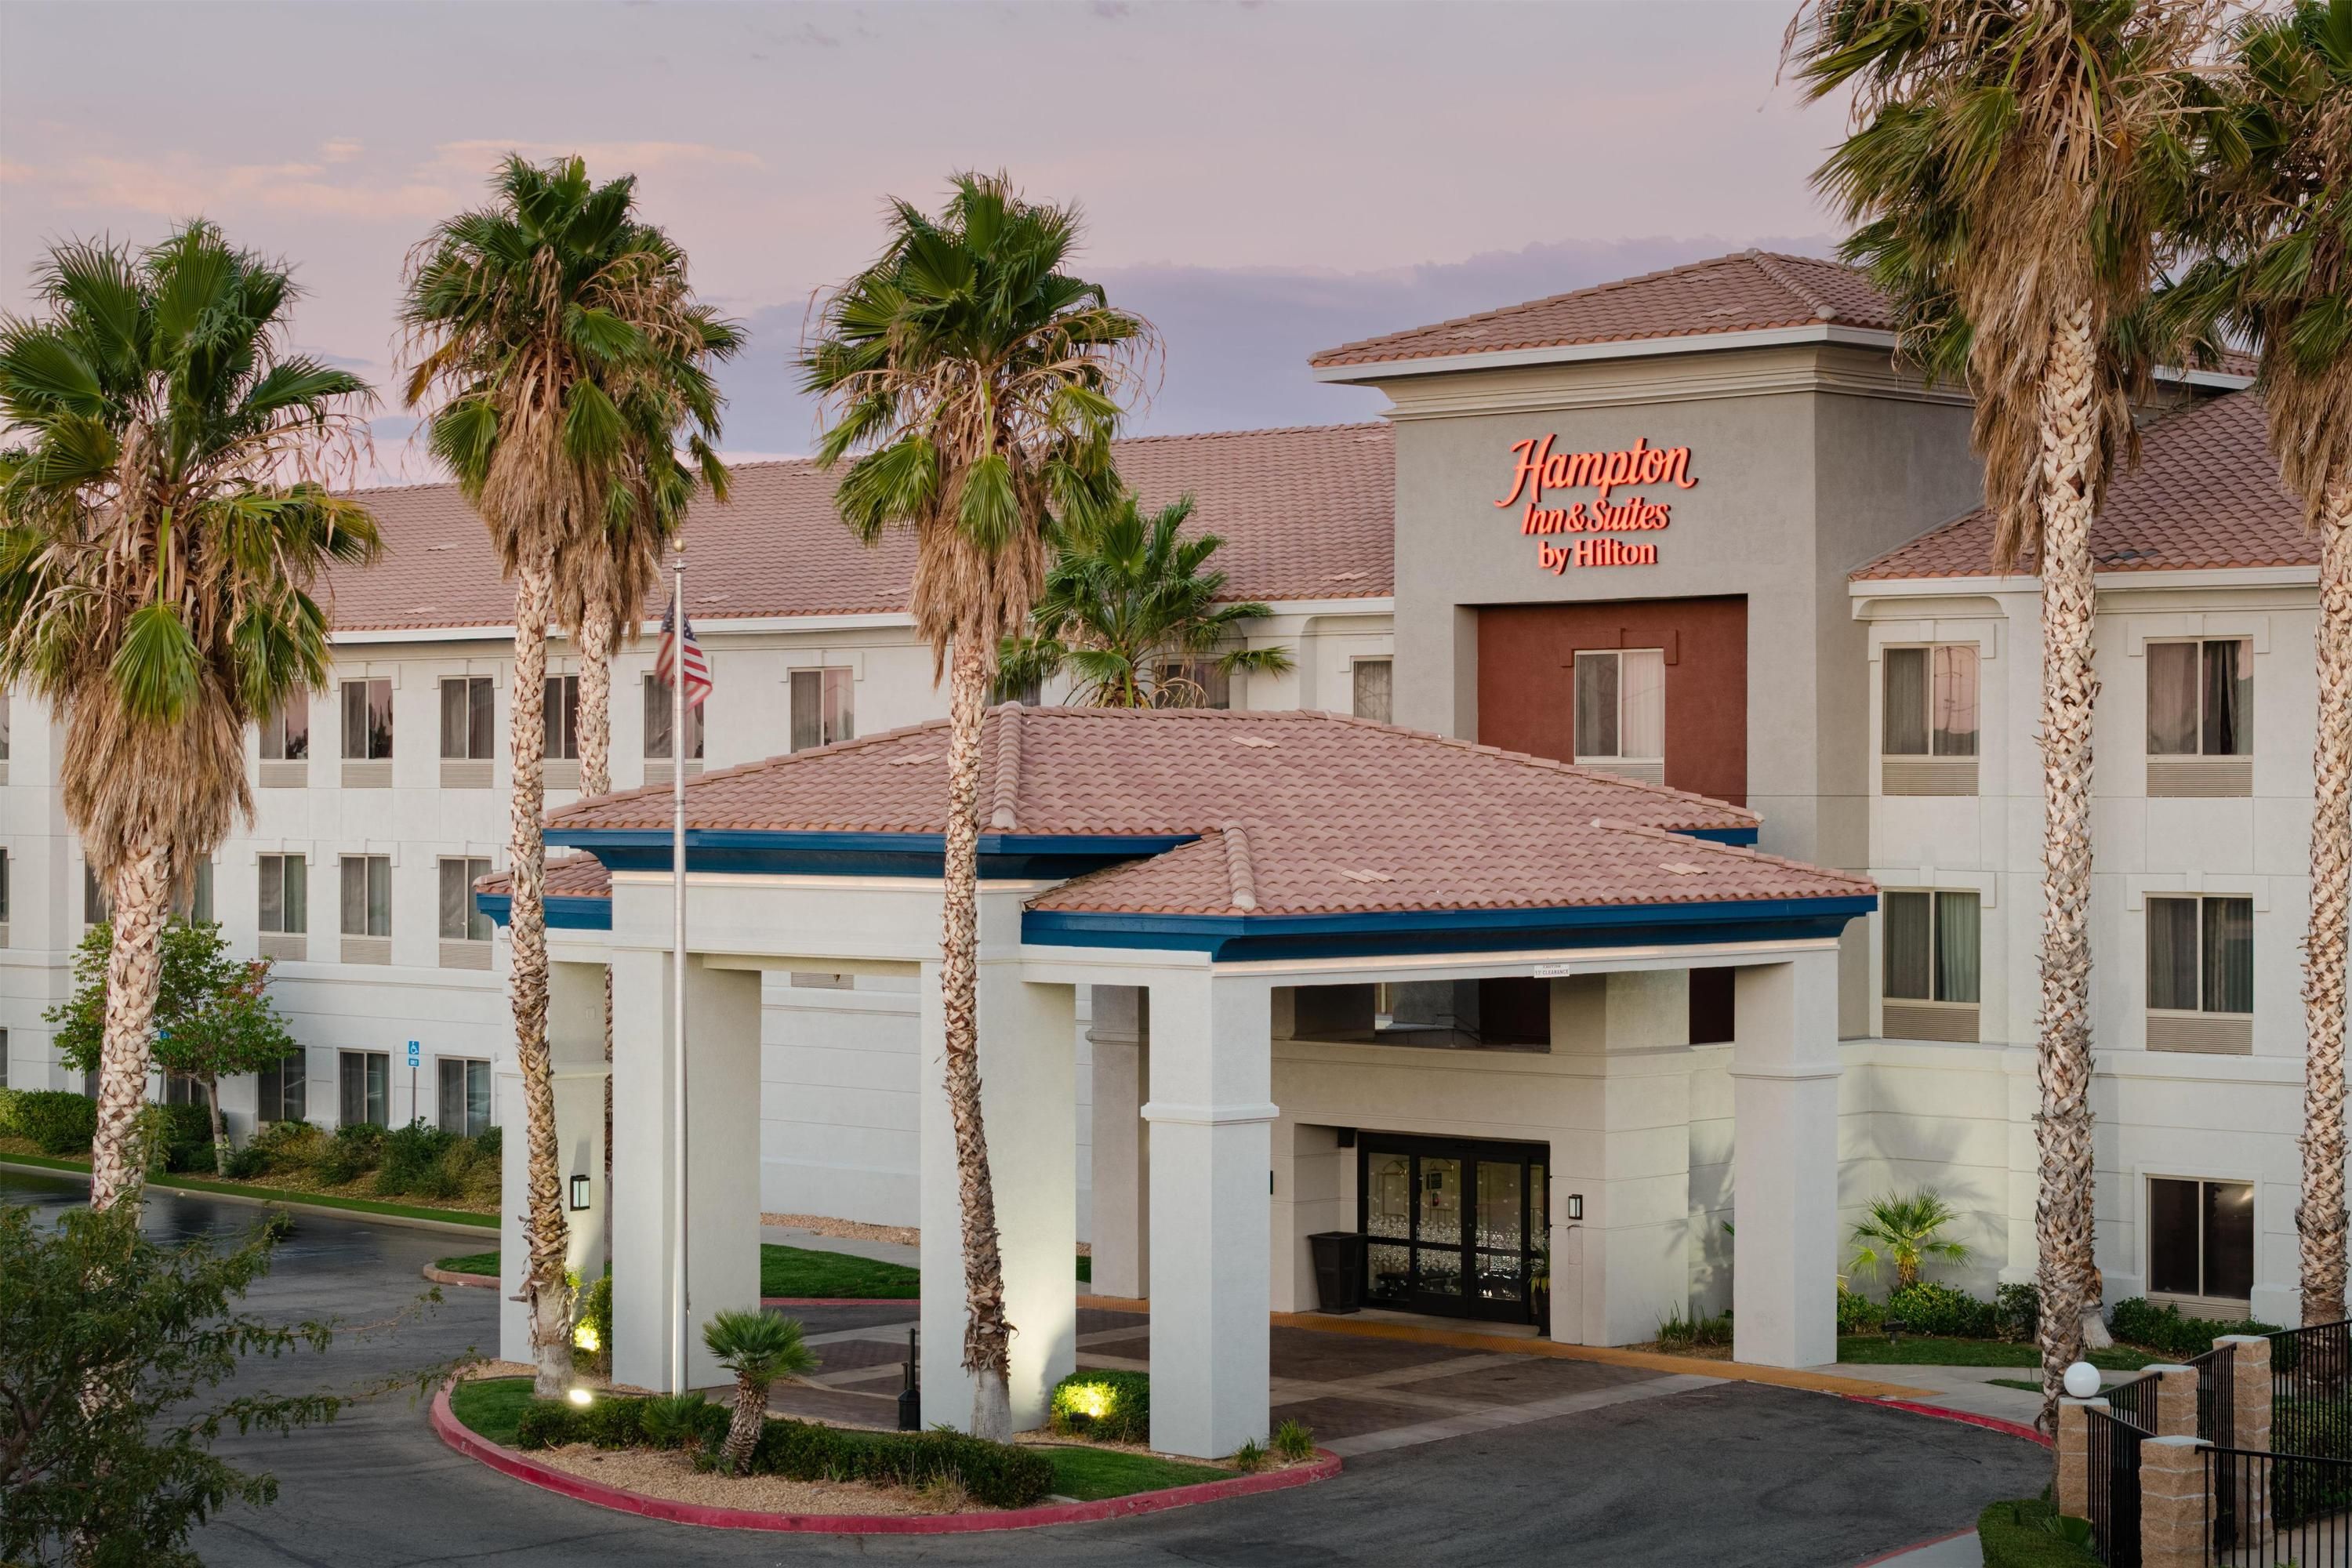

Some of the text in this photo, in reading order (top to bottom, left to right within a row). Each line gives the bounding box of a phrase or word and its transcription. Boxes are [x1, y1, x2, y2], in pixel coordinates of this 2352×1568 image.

[1494, 433, 1699, 508] Hampton
[1521, 503, 1567, 535] Inn
[1588, 496, 1671, 533] Suites
[1538, 538, 1659, 575] by Hilton
